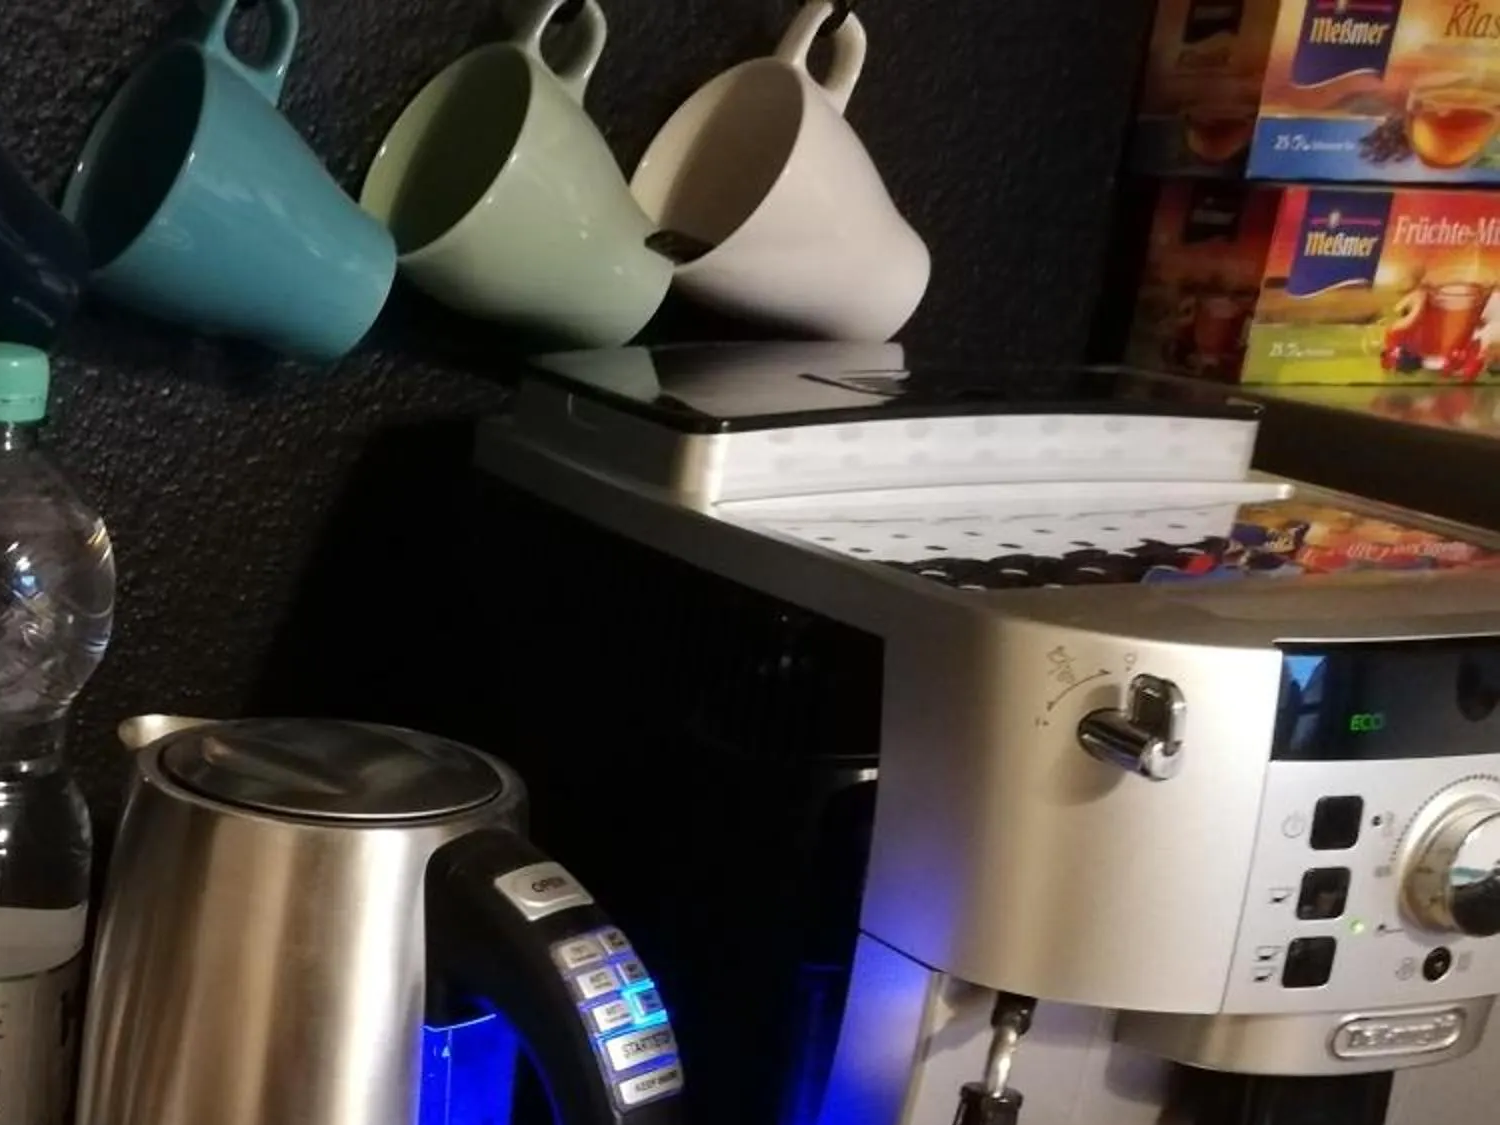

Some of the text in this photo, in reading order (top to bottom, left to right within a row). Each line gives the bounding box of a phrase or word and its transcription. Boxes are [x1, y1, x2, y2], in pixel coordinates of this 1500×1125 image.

[1309, 16, 1390, 46] Meßmer
[1304, 230, 1379, 258] Meßmer
[1350, 712, 1385, 731] ECO
